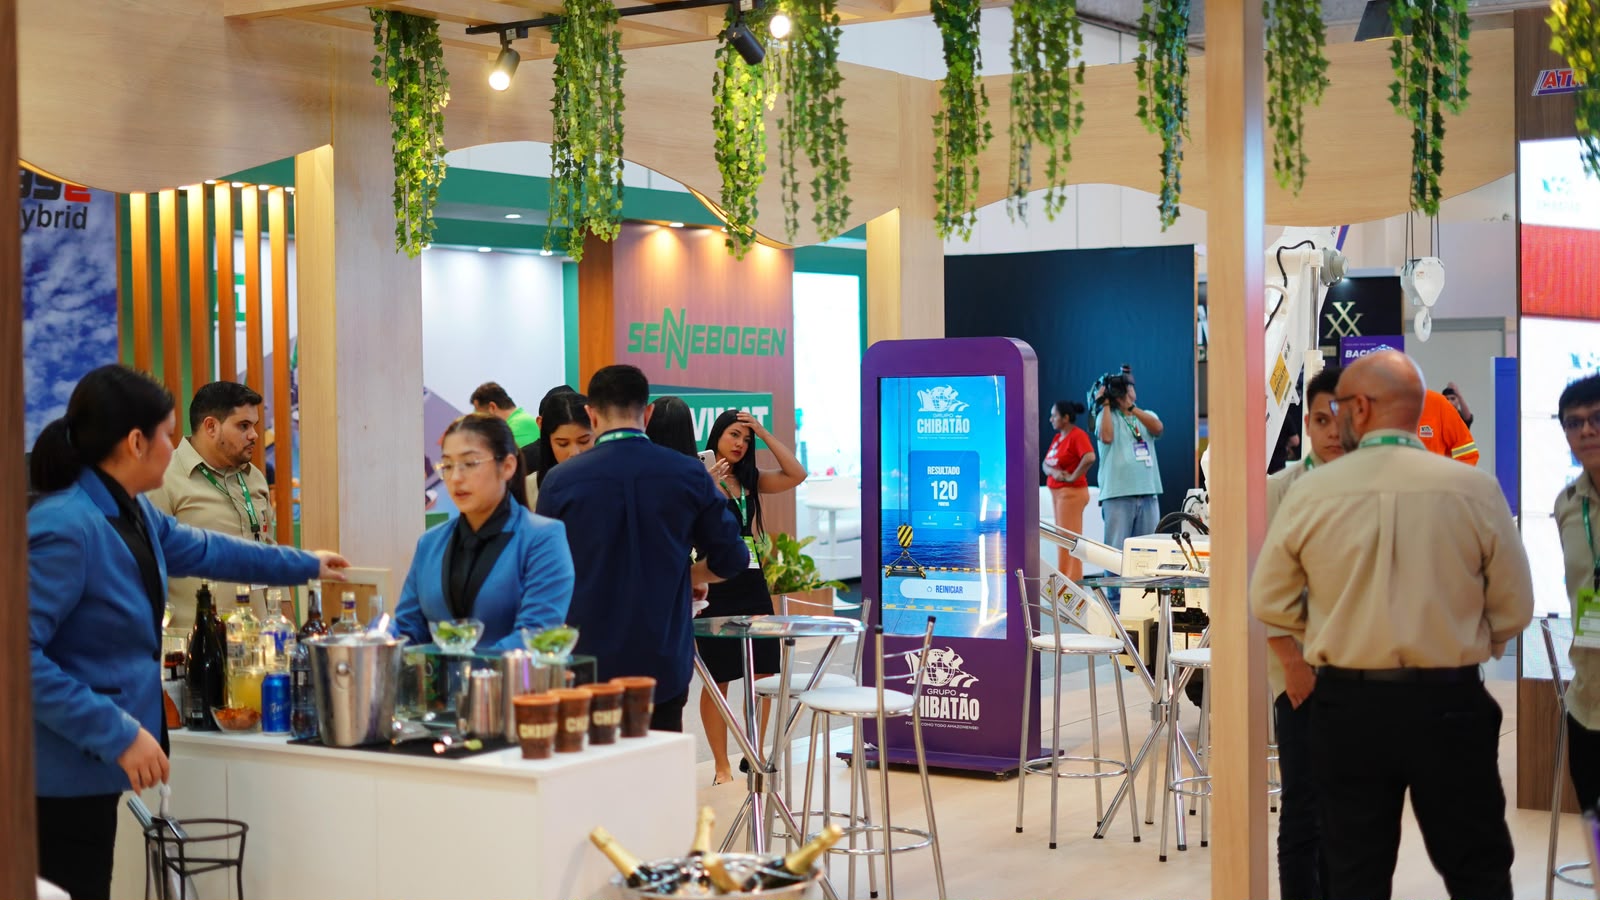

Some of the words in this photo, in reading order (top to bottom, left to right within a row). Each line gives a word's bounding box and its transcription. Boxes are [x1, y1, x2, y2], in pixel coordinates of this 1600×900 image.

[21, 203, 88, 232] ybrid
[627, 307, 787, 370] SENNEBOGEN
[917, 415, 970, 434] CHIBATÃO
[927, 466, 961, 475] RESULTADO
[930, 480, 958, 501] 120
[935, 585, 964, 594] REINICIAR
[926, 688, 957, 696] GRUPO
[917, 693, 980, 721] HIBATÃO
